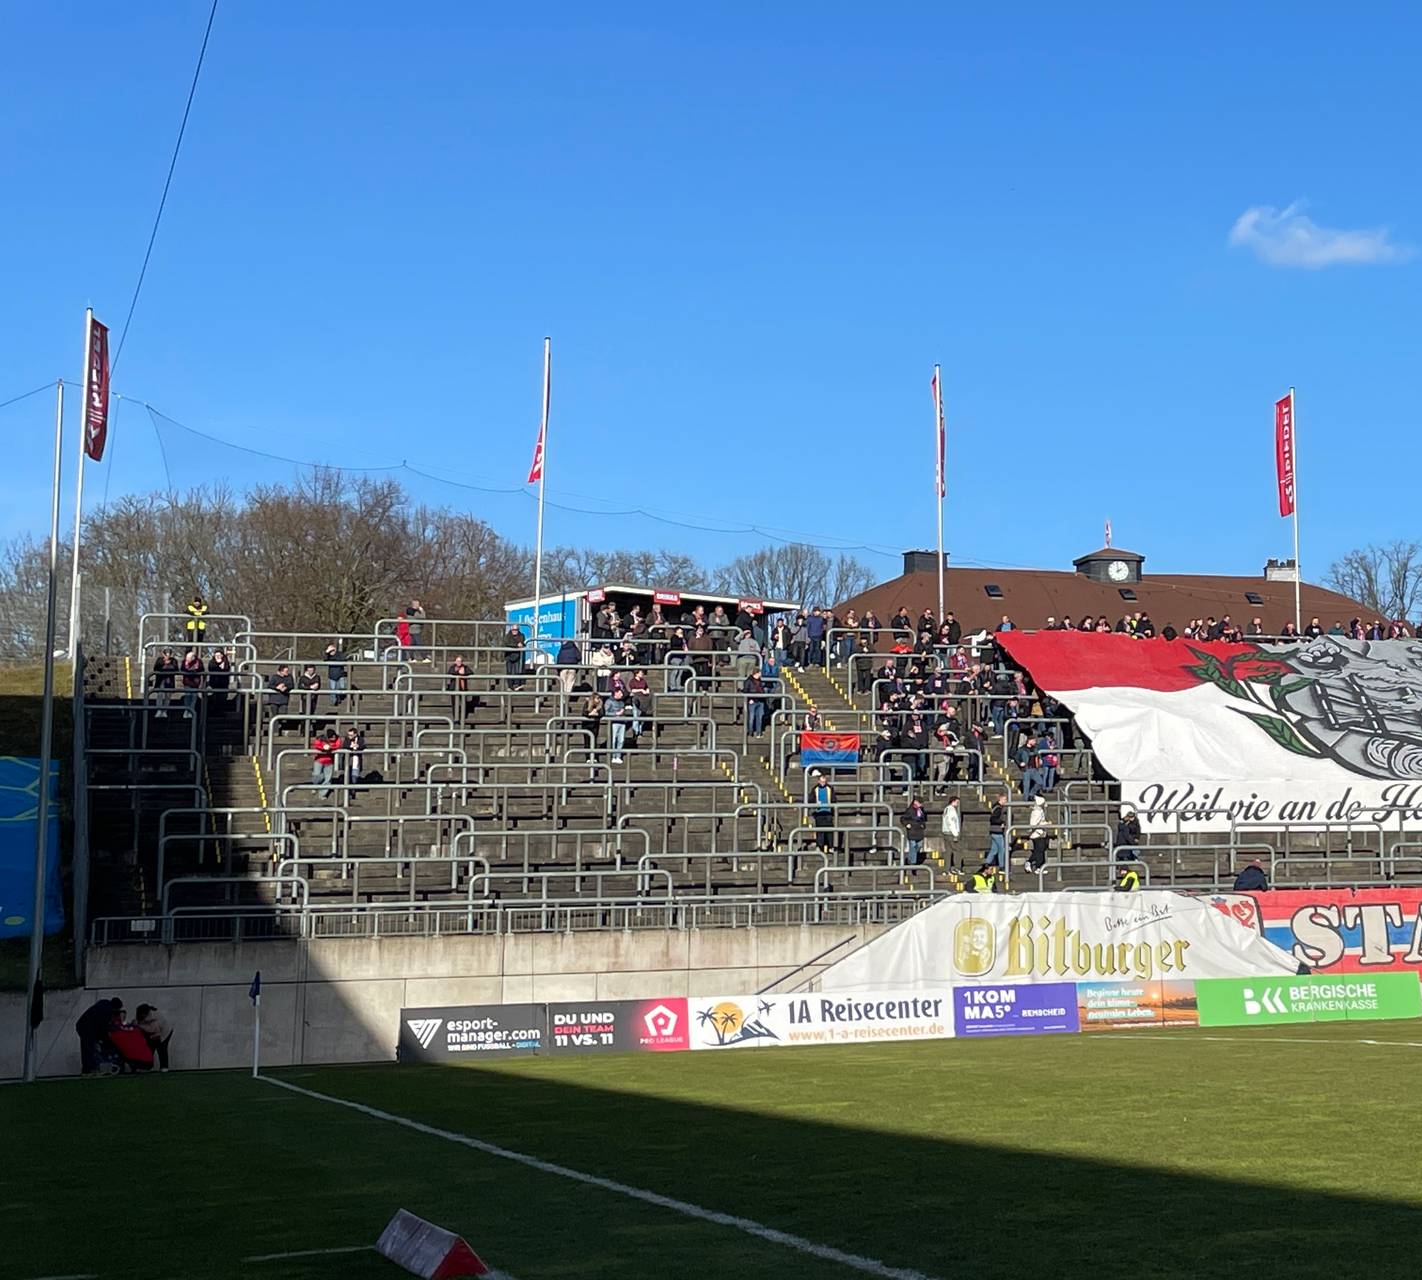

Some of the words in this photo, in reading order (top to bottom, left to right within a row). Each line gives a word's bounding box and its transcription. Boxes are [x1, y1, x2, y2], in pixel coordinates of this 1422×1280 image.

[1139, 782, 1225, 823] Weil
[1229, 793, 1274, 821] vie
[1278, 799, 1323, 821] an
[1325, 787, 1366, 821] de
[1002, 914, 1191, 981] Bitburger
[963, 989, 1016, 1004] 1KOM
[1289, 984, 1377, 1000] BERGISCHE
[788, 1000, 812, 1024] 1A
[820, 998, 942, 1022] Reisecenter
[1291, 999, 1378, 1013] KRANKENKASSE
[447, 1017, 498, 1032] esport-
[554, 1014, 576, 1025] DU
[580, 1012, 615, 1024] UND
[447, 1029, 541, 1044] manager.com
[554, 1025, 581, 1034] DEIN
[584, 1024, 614, 1033] TEAM
[788, 1023, 945, 1041] www.1-a-reisecenter.de
[554, 1034, 564, 1046] 11
[571, 1034, 598, 1046] VS.
[600, 1033, 613, 1045] 11
[656, 1036, 683, 1044] LEAGUE
